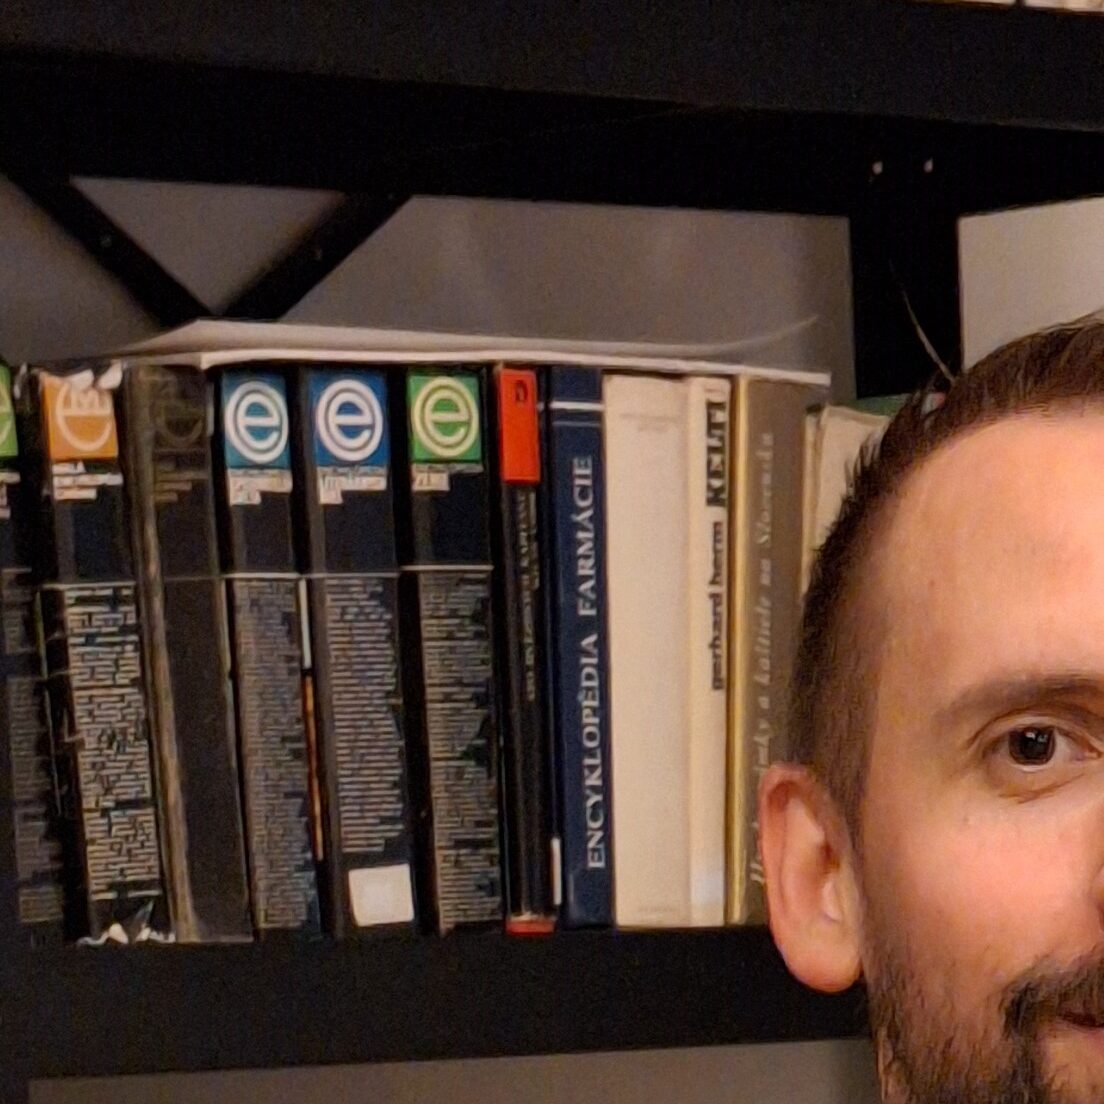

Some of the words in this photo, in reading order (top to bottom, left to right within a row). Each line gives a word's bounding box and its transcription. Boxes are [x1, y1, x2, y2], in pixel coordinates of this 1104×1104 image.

[571, 454, 598, 616] FARMÁCIE
[708, 590, 724, 691] gerhard
[577, 632, 606, 870] ENCYKLOPÉDIA
